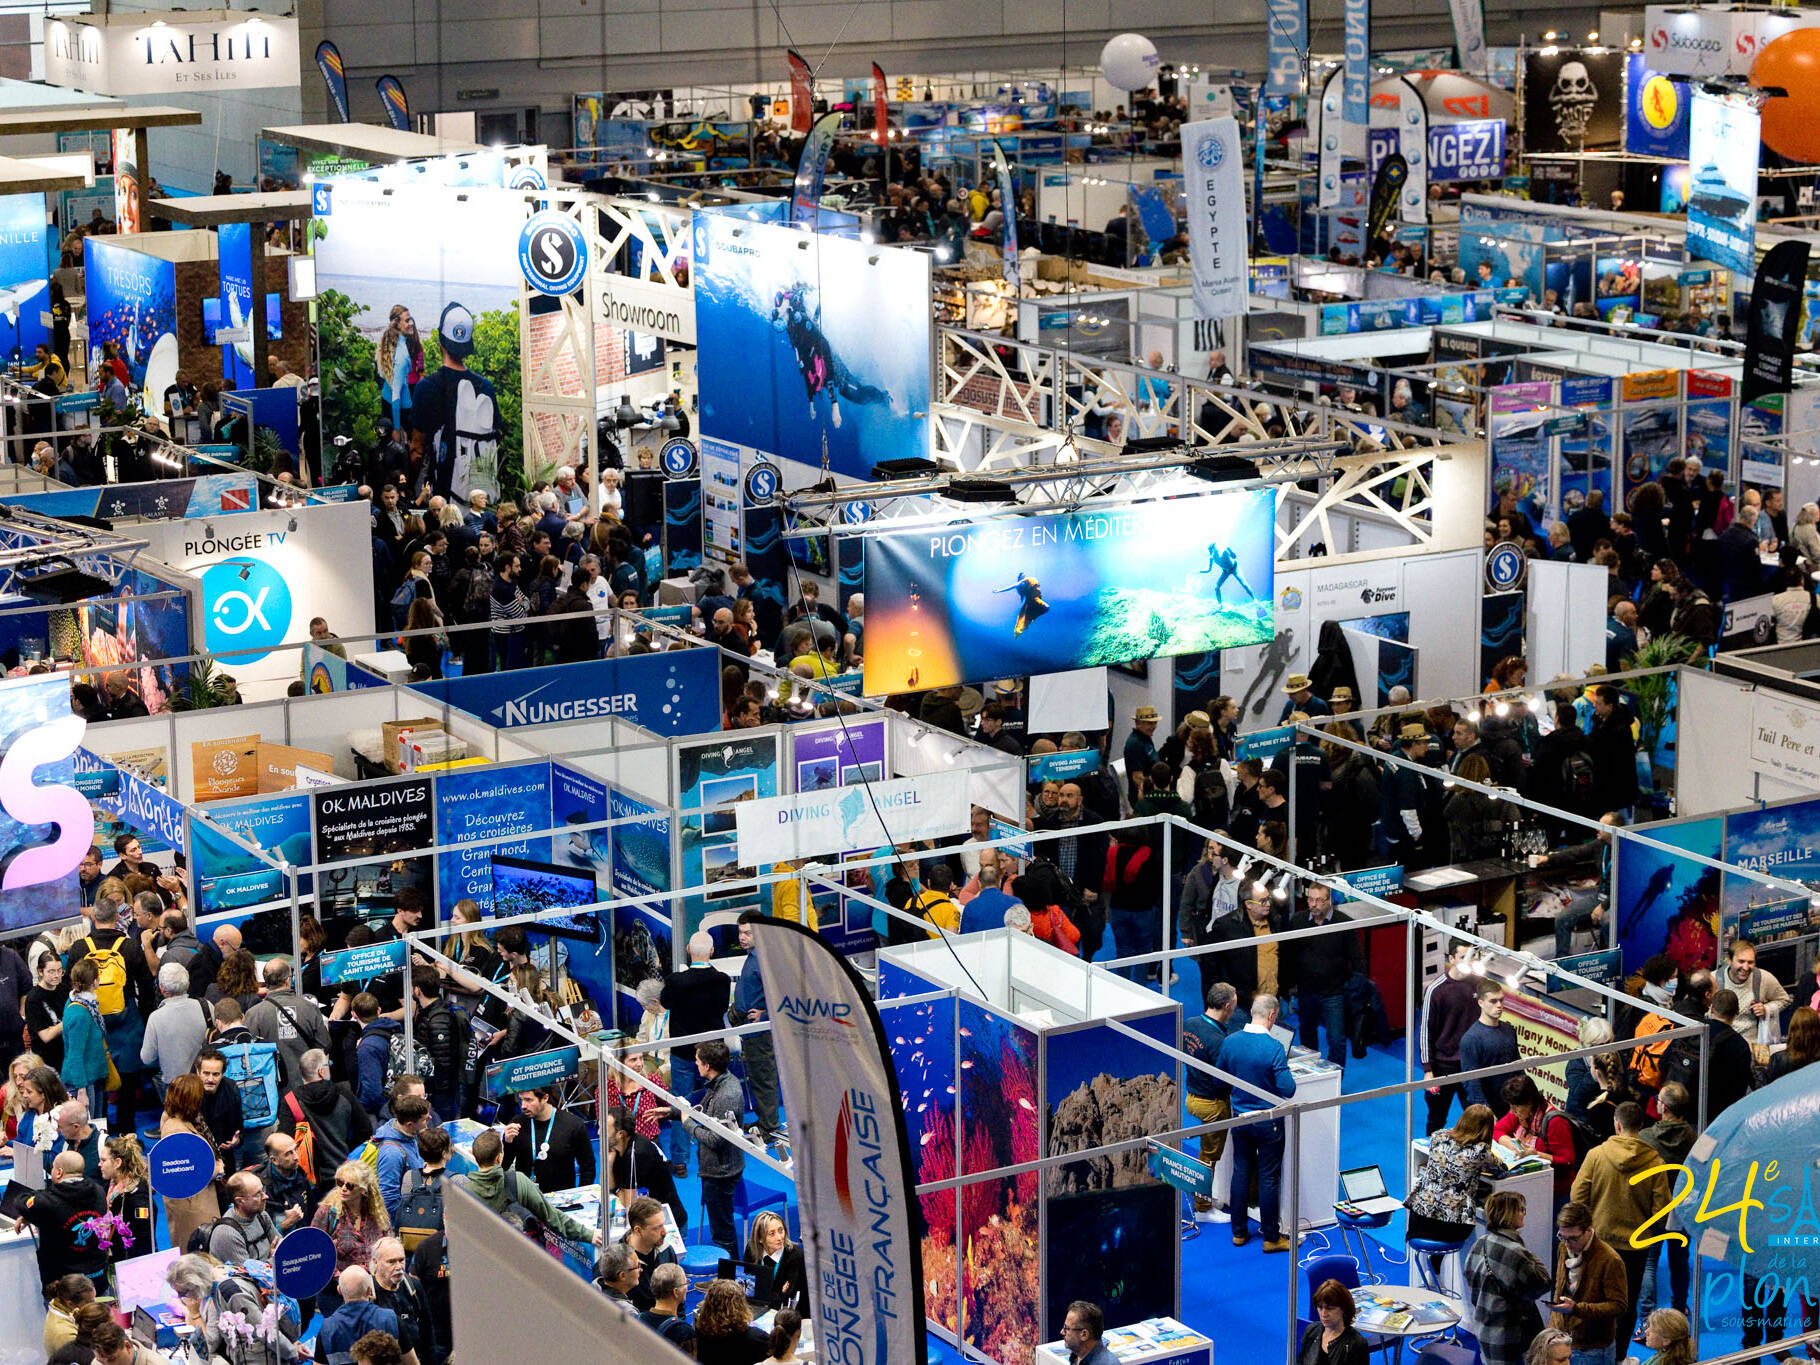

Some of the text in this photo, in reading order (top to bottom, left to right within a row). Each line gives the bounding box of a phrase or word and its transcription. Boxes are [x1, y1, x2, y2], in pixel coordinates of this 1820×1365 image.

[1206, 179, 1222, 270] EGYPTE
[602, 292, 680, 334] Showroom
[1032, 525, 1057, 547] EN
[1064, 515, 1145, 543] MÉDITER
[185, 531, 287, 556] PLONGÉE TV
[1374, 592, 1396, 602] Dive
[506, 693, 638, 727] NUNGESSER
[1758, 726, 1777, 745] Tuil
[701, 746, 754, 760] DIVING ANGEL
[268, 764, 279, 774] En
[75, 778, 104, 786] ONGEURS
[322, 787, 426, 814] OK MALDIVES
[442, 782, 545, 803] www.okmaldives.com
[235, 814, 285, 831] MALDIVES
[465, 811, 526, 827] Découvrez
[778, 803, 831, 825] DIVING
[322, 822, 357, 836] Spécialiste
[358, 819, 367, 828] de
[346, 829, 376, 841] Maldives
[376, 825, 398, 837] depuis
[457, 823, 533, 842] nos croisières
[462, 843, 498, 861] Grand
[1737, 847, 1813, 871] MARSEILLE
[461, 864, 492, 878] Centr
[226, 883, 269, 895] OK MALDIVES
[833, 936, 875, 948] ing-angel.com
[347, 958, 381, 968] TOURISME
[351, 948, 386, 961] OFFICE DU
[343, 967, 364, 976] SAINT
[365, 961, 396, 972] RAPHAEL
[1577, 959, 1600, 968] OFFICE
[511, 1065, 566, 1083] MEDITERRANEE
[513, 1058, 563, 1075] OT PROVENCE
[162, 1158, 190, 1168] Seadoors
[1162, 1156, 1205, 1182] FRANCE STATION
[1170, 1168, 1197, 1186] NAUTIQUE
[850, 1087, 898, 1319] FRANÇAISE
